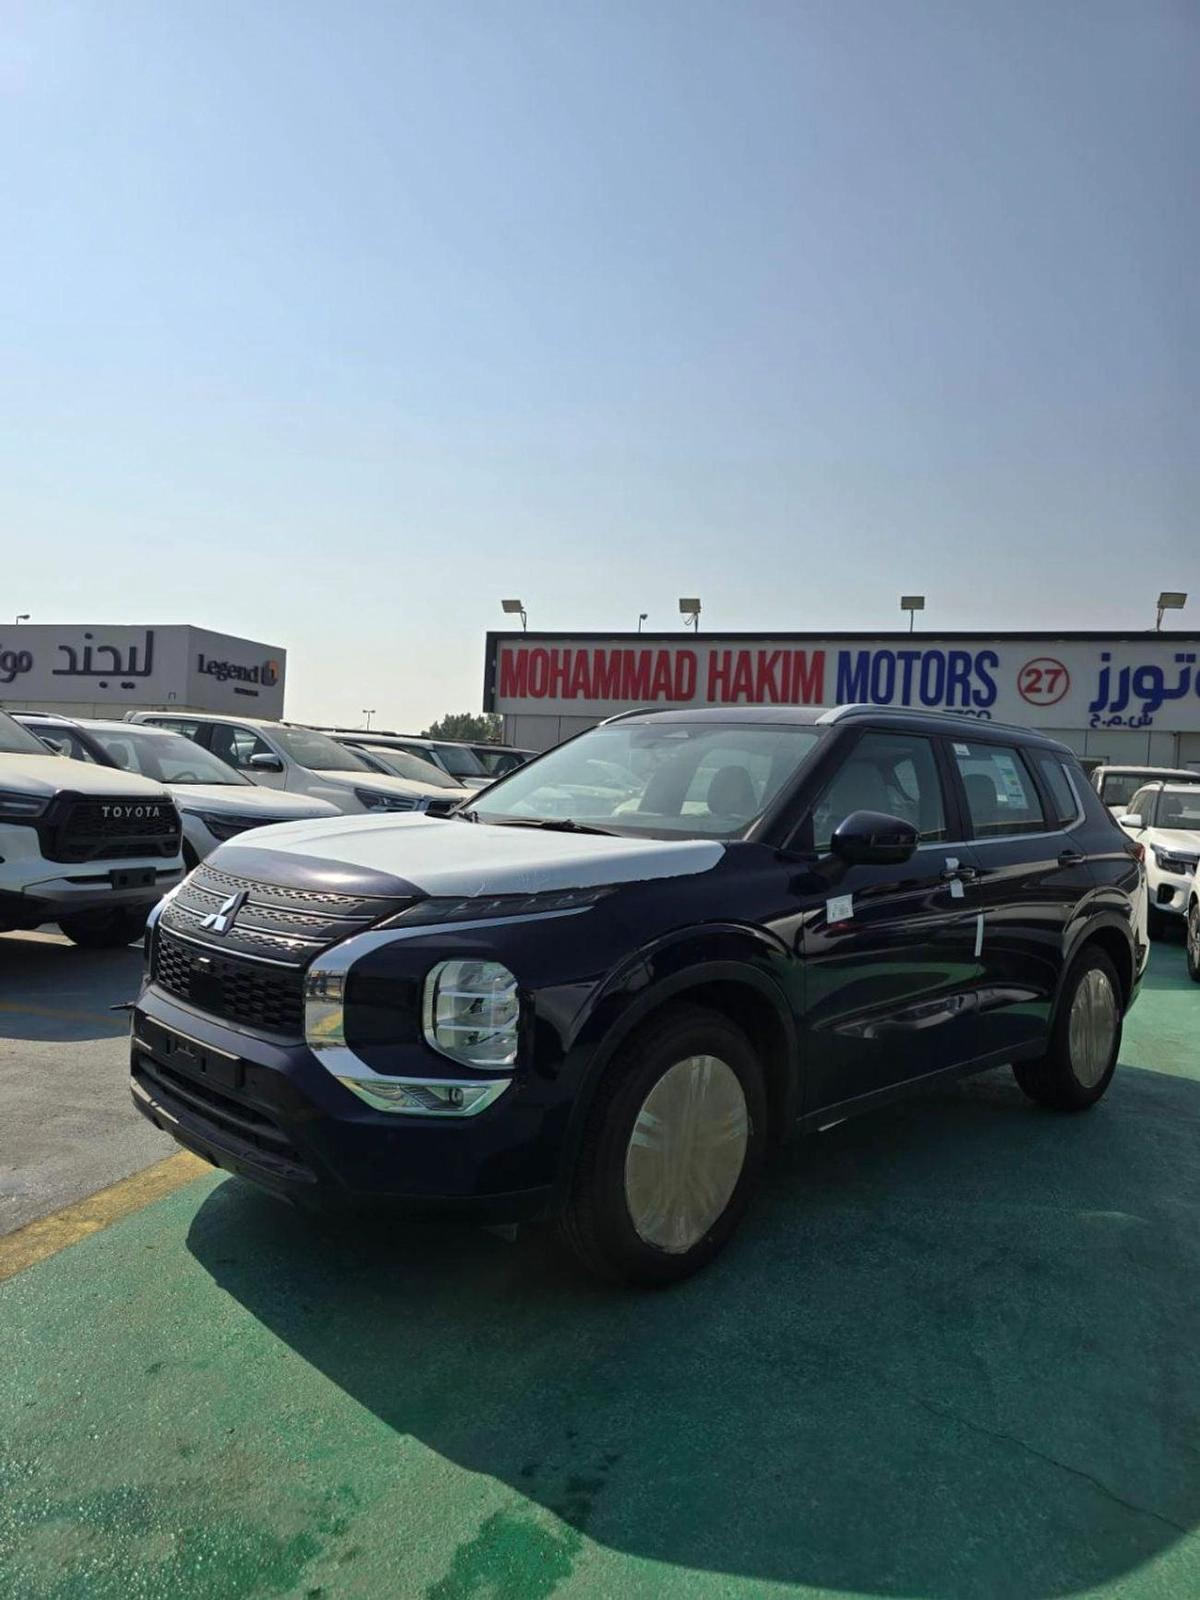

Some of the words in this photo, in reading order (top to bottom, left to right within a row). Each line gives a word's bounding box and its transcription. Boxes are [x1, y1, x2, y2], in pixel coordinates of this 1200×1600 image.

[0, 644, 33, 683] مو
[52, 630, 154, 689] ليجند
[197, 653, 259, 684] Legend
[499, 648, 698, 701] MOHAMMAD
[707, 650, 826, 704] HAKIM
[835, 648, 999, 707] MOTORS
[1022, 668, 1064, 694] 27
[1088, 652, 1200, 713] تورز
[101, 805, 161, 818] TOYOTA
